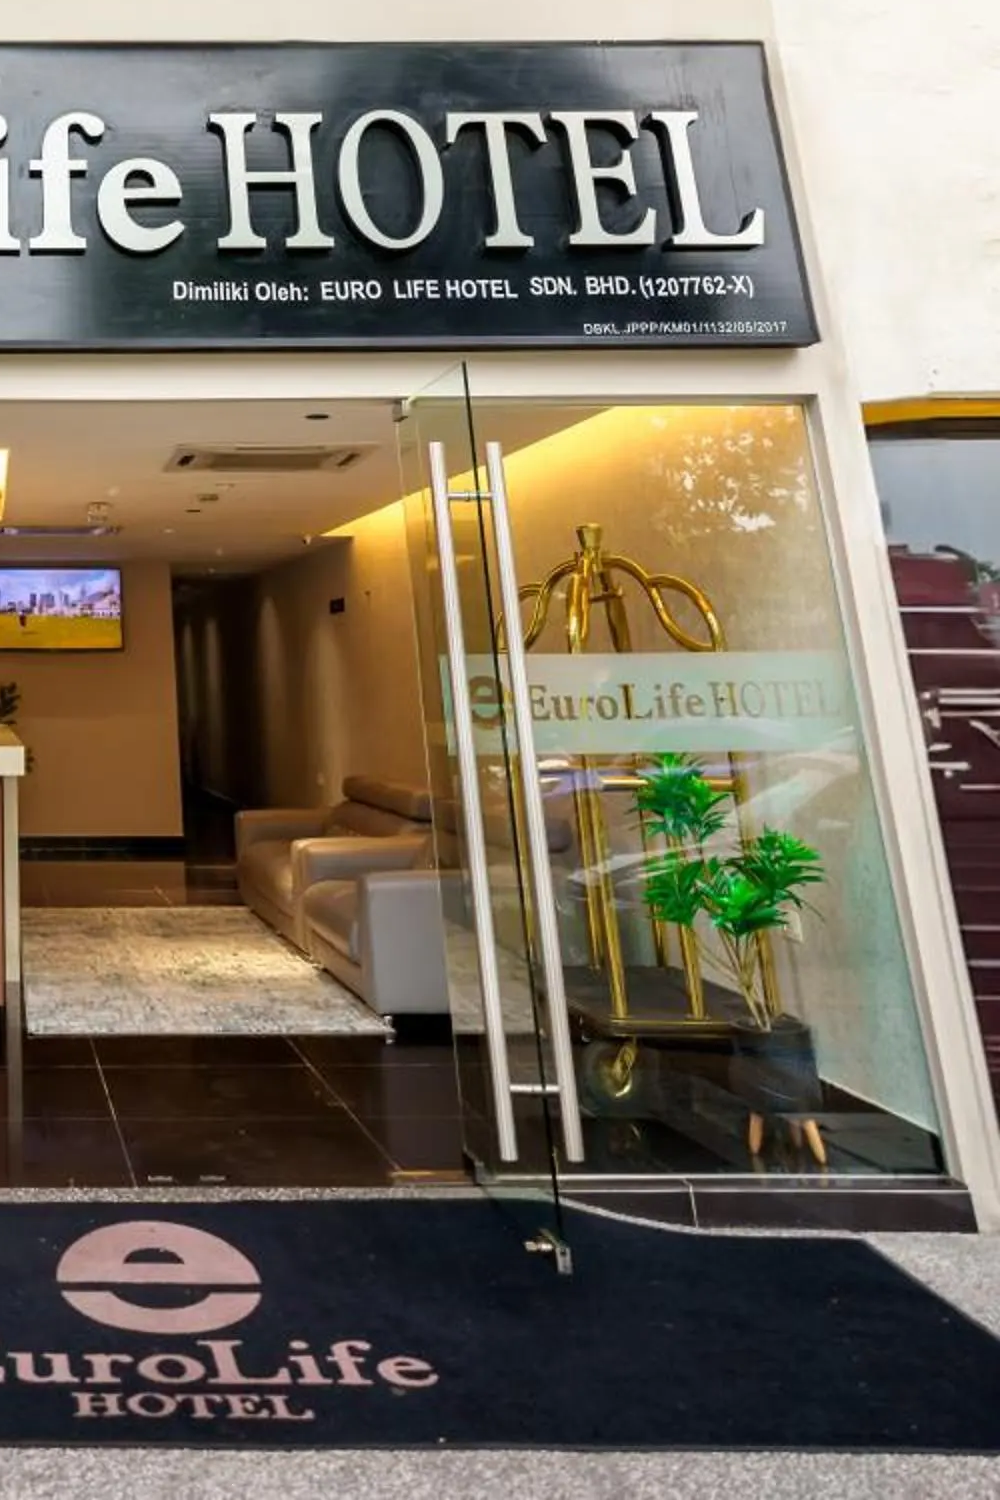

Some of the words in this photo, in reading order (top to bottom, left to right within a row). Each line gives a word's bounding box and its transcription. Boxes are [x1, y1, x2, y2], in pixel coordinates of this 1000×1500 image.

[209, 108, 765, 251] HOTEL
[172, 280, 249, 301] Dimiliki
[255, 281, 309, 301] Oleh:
[320, 280, 382, 300] EURO
[393, 279, 440, 299] LIFE
[446, 278, 518, 299] HOTEL
[529, 276, 577, 296] SDN.
[585, 275, 637, 296] BHD.
[639, 275, 754, 299] (1207762-X)
[529, 682, 706, 722] EuroLife
[708, 678, 841, 719] HOTEL
[72, 1392, 316, 1421] HOTEL
